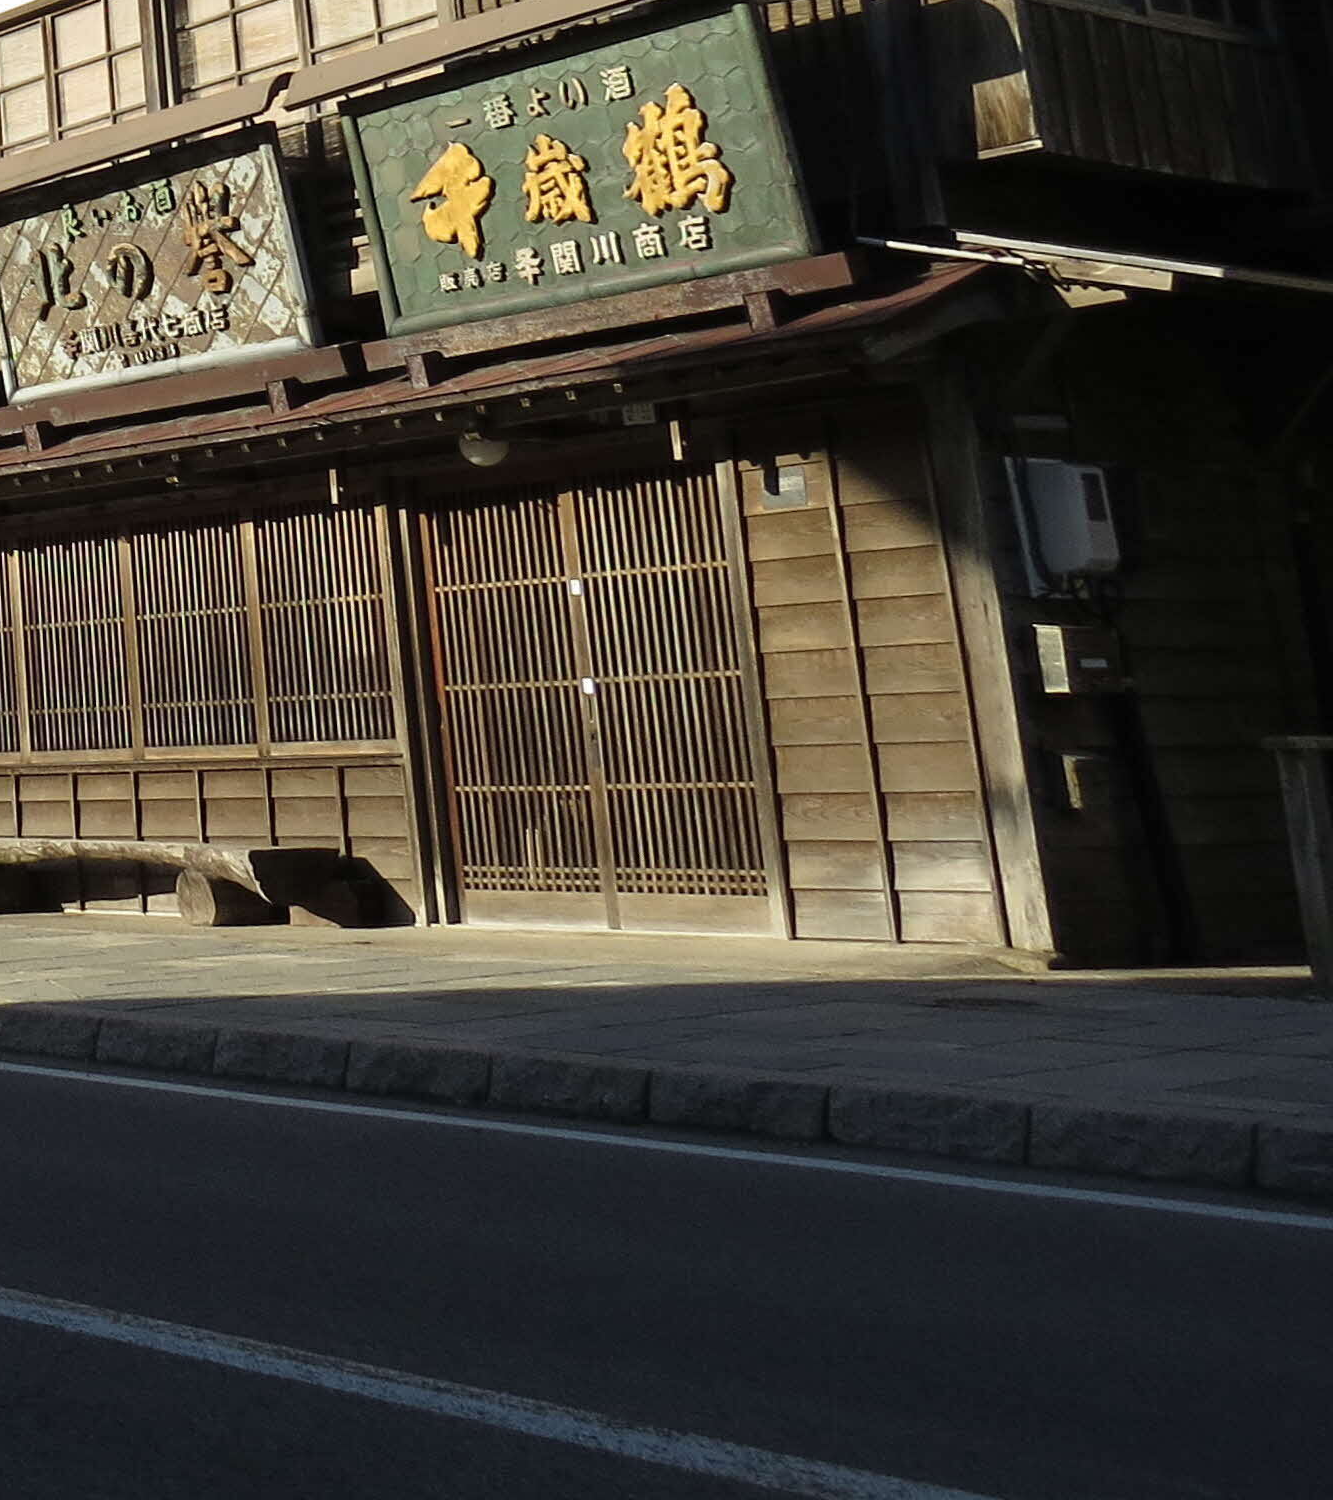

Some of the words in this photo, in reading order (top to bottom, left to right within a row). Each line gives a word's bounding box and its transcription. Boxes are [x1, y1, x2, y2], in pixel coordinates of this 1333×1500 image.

[445, 65, 634, 130] 一番より酒
[410, 82, 735, 259] 千歳鶴
[549, 214, 711, 276] 関川商店
